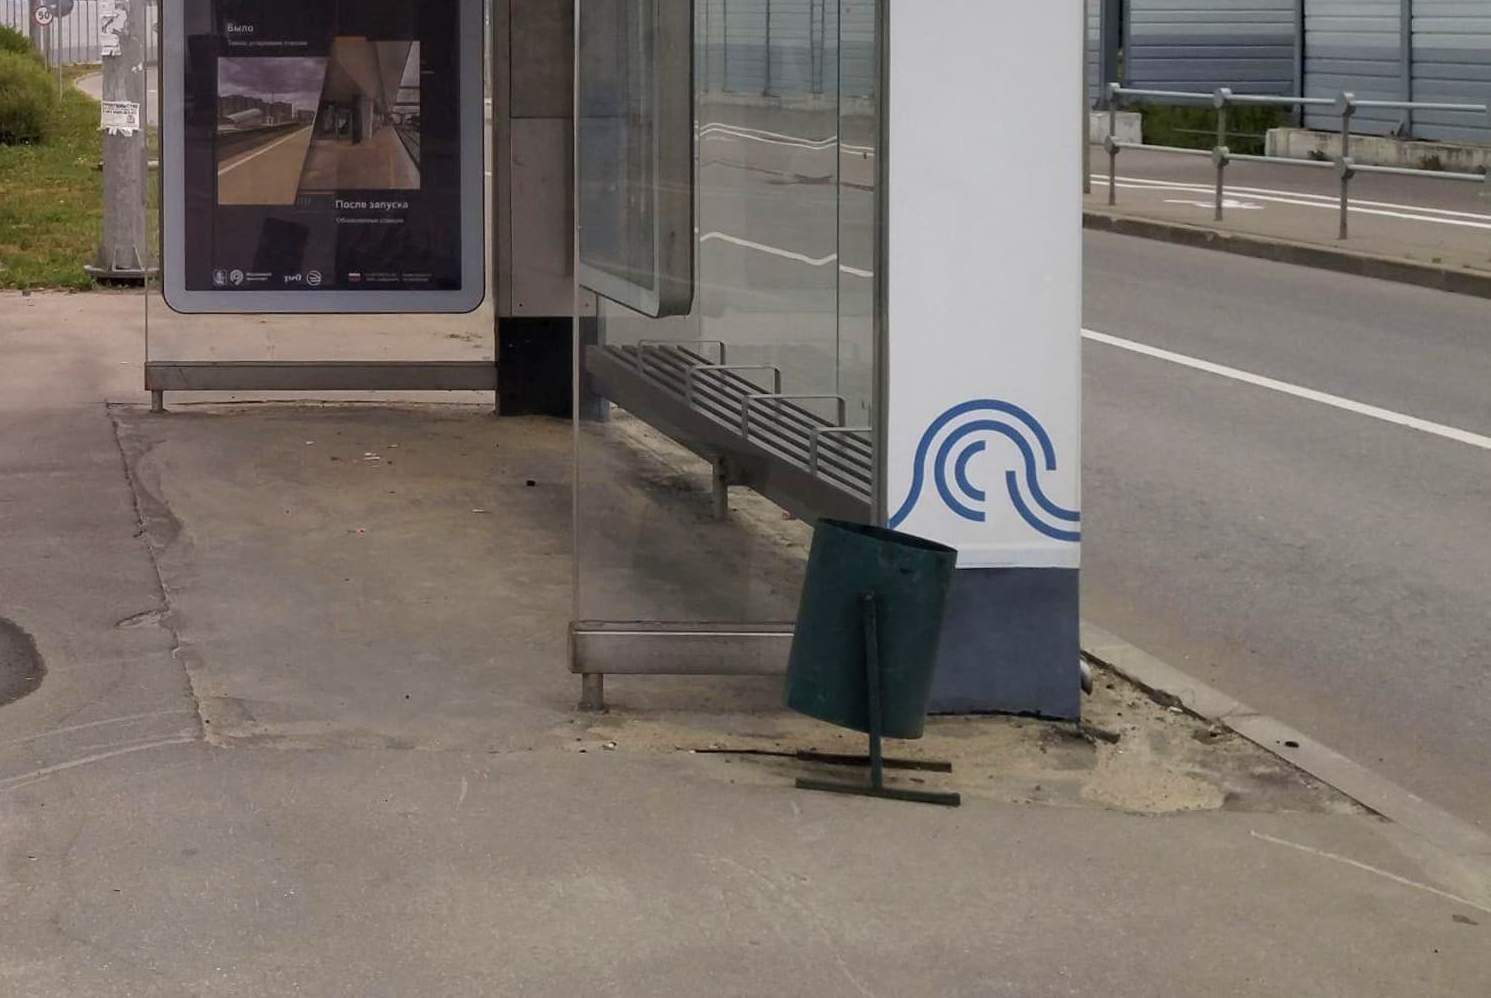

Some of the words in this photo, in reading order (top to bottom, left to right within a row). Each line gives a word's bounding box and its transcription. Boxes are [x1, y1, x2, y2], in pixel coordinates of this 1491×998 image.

[227, 23, 254, 33] Было
[335, 200, 367, 209] После
[369, 201, 409, 211] запуска
